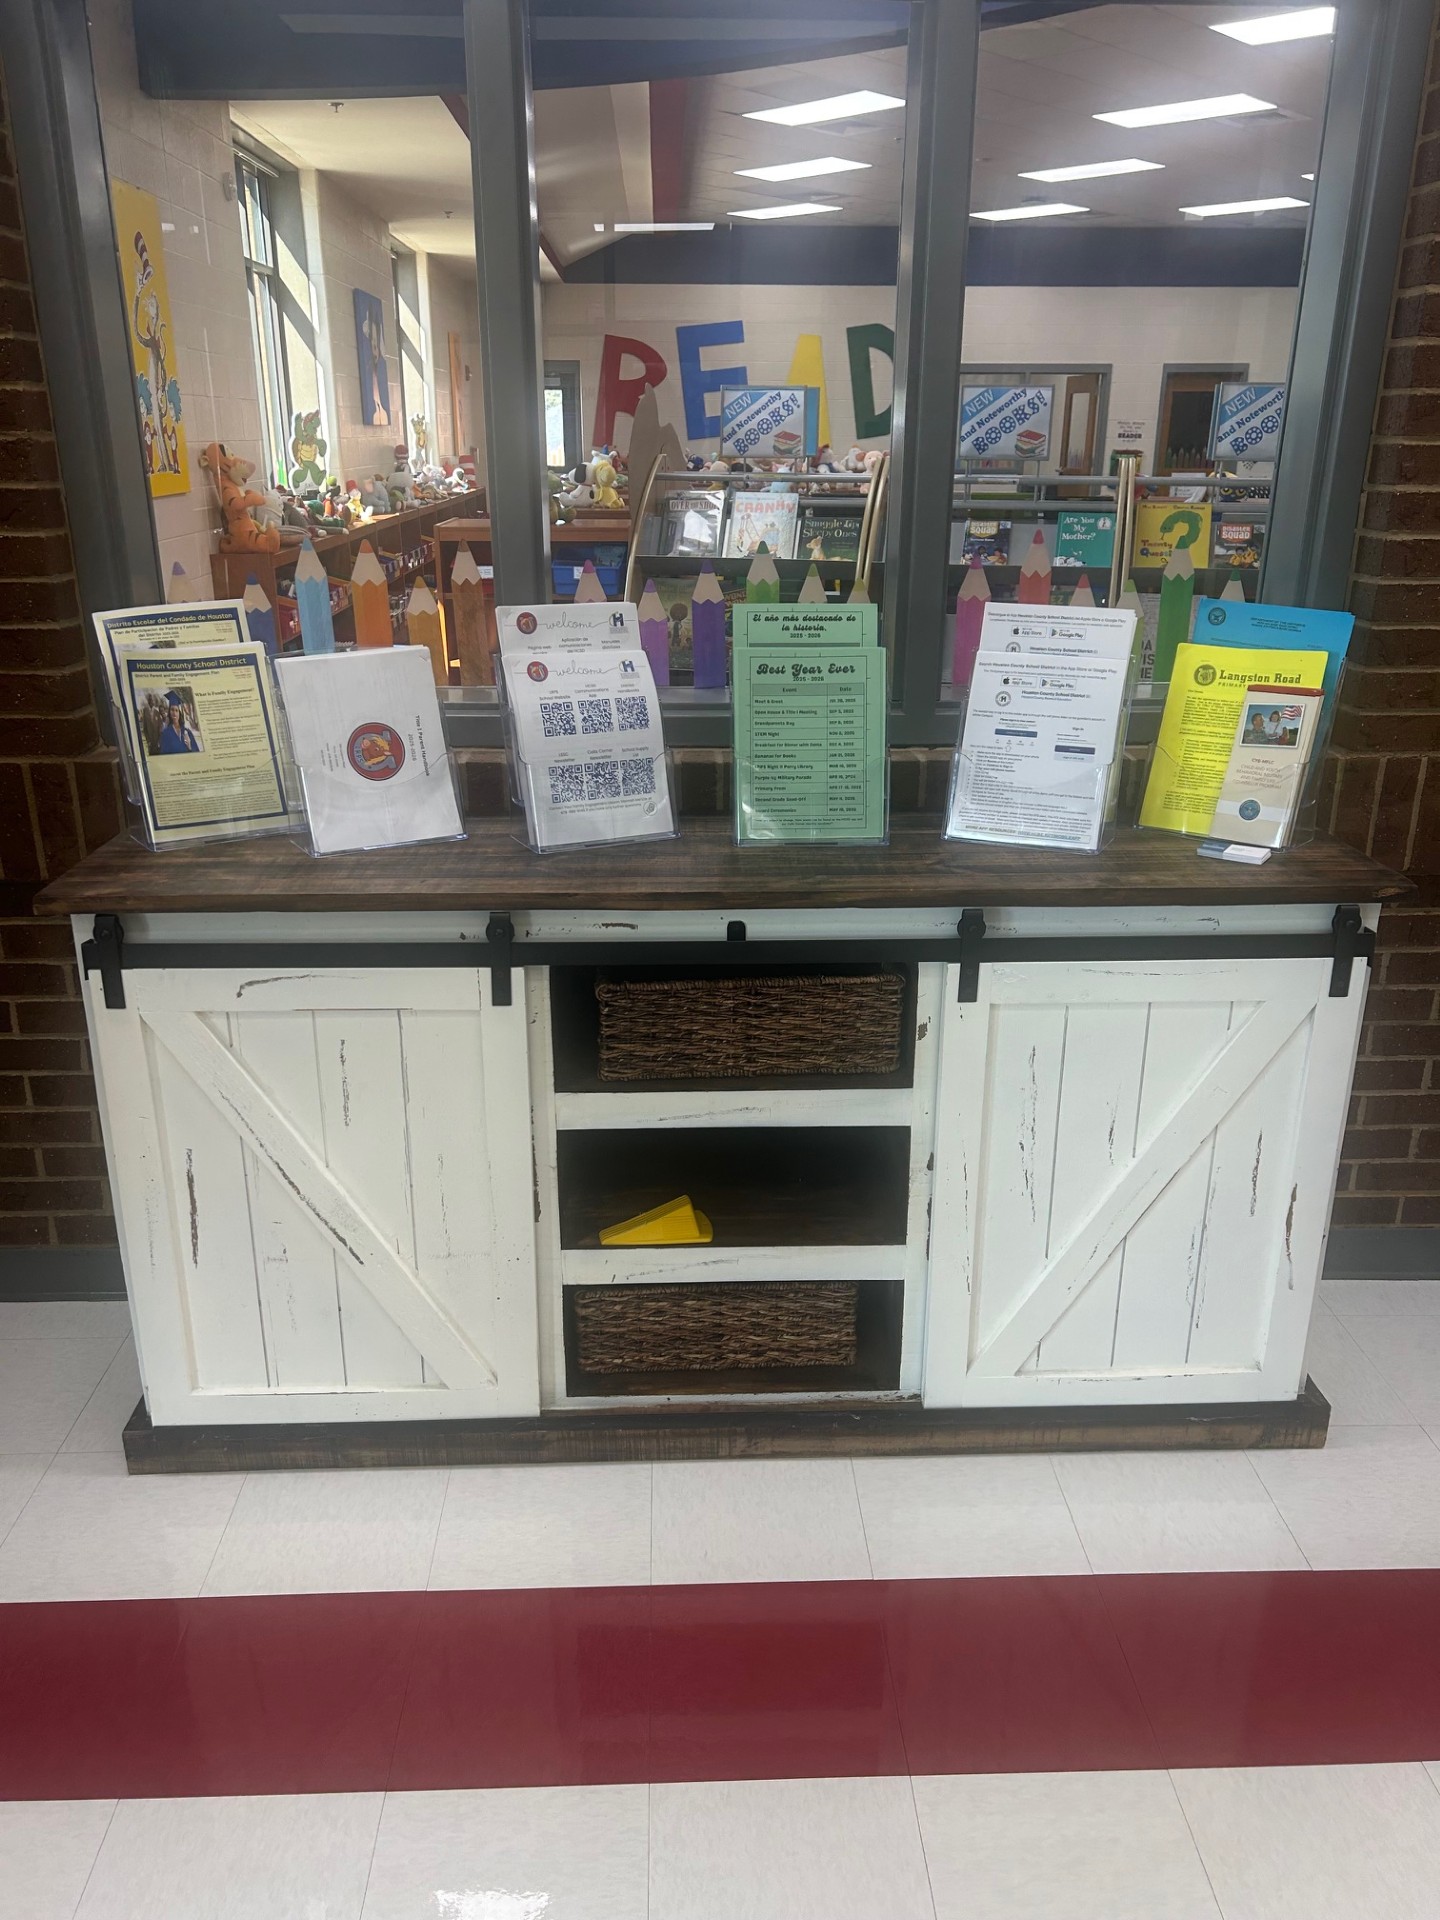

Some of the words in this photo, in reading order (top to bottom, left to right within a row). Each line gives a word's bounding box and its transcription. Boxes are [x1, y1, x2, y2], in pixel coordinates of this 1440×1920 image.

[725, 393, 752, 418] NEW
[964, 390, 994, 416] NEW
[1225, 386, 1256, 416] NEW
[722, 428, 738, 443] and
[736, 391, 782, 430] Noteworthy
[960, 425, 977, 442] and
[976, 388, 1028, 428] Noteworthy
[972, 390, 1048, 455] BOOKS!
[1216, 425, 1236, 442] and
[1236, 390, 1285, 428] Noteworth
[733, 393, 800, 456] BOOKS!
[804, 519, 842, 529] Snuggle
[1073, 524, 1086, 532] My
[802, 528, 834, 540] Sleepy
[834, 529, 858, 538] Ones
[1062, 532, 1096, 541] Mother?
[170, 615, 196, 623] Condado
[545, 612, 594, 630] welcome
[793, 624, 826, 632] historia.
[136, 662, 165, 670] Houston
[166, 662, 192, 670] County
[220, 658, 247, 666] District
[556, 660, 606, 676] welcome
[756, 664, 786, 675] Best
[791, 664, 823, 677] Year
[828, 663, 856, 674] Ever
[1219, 670, 1270, 684] Langston
[1274, 674, 1301, 684] Road
